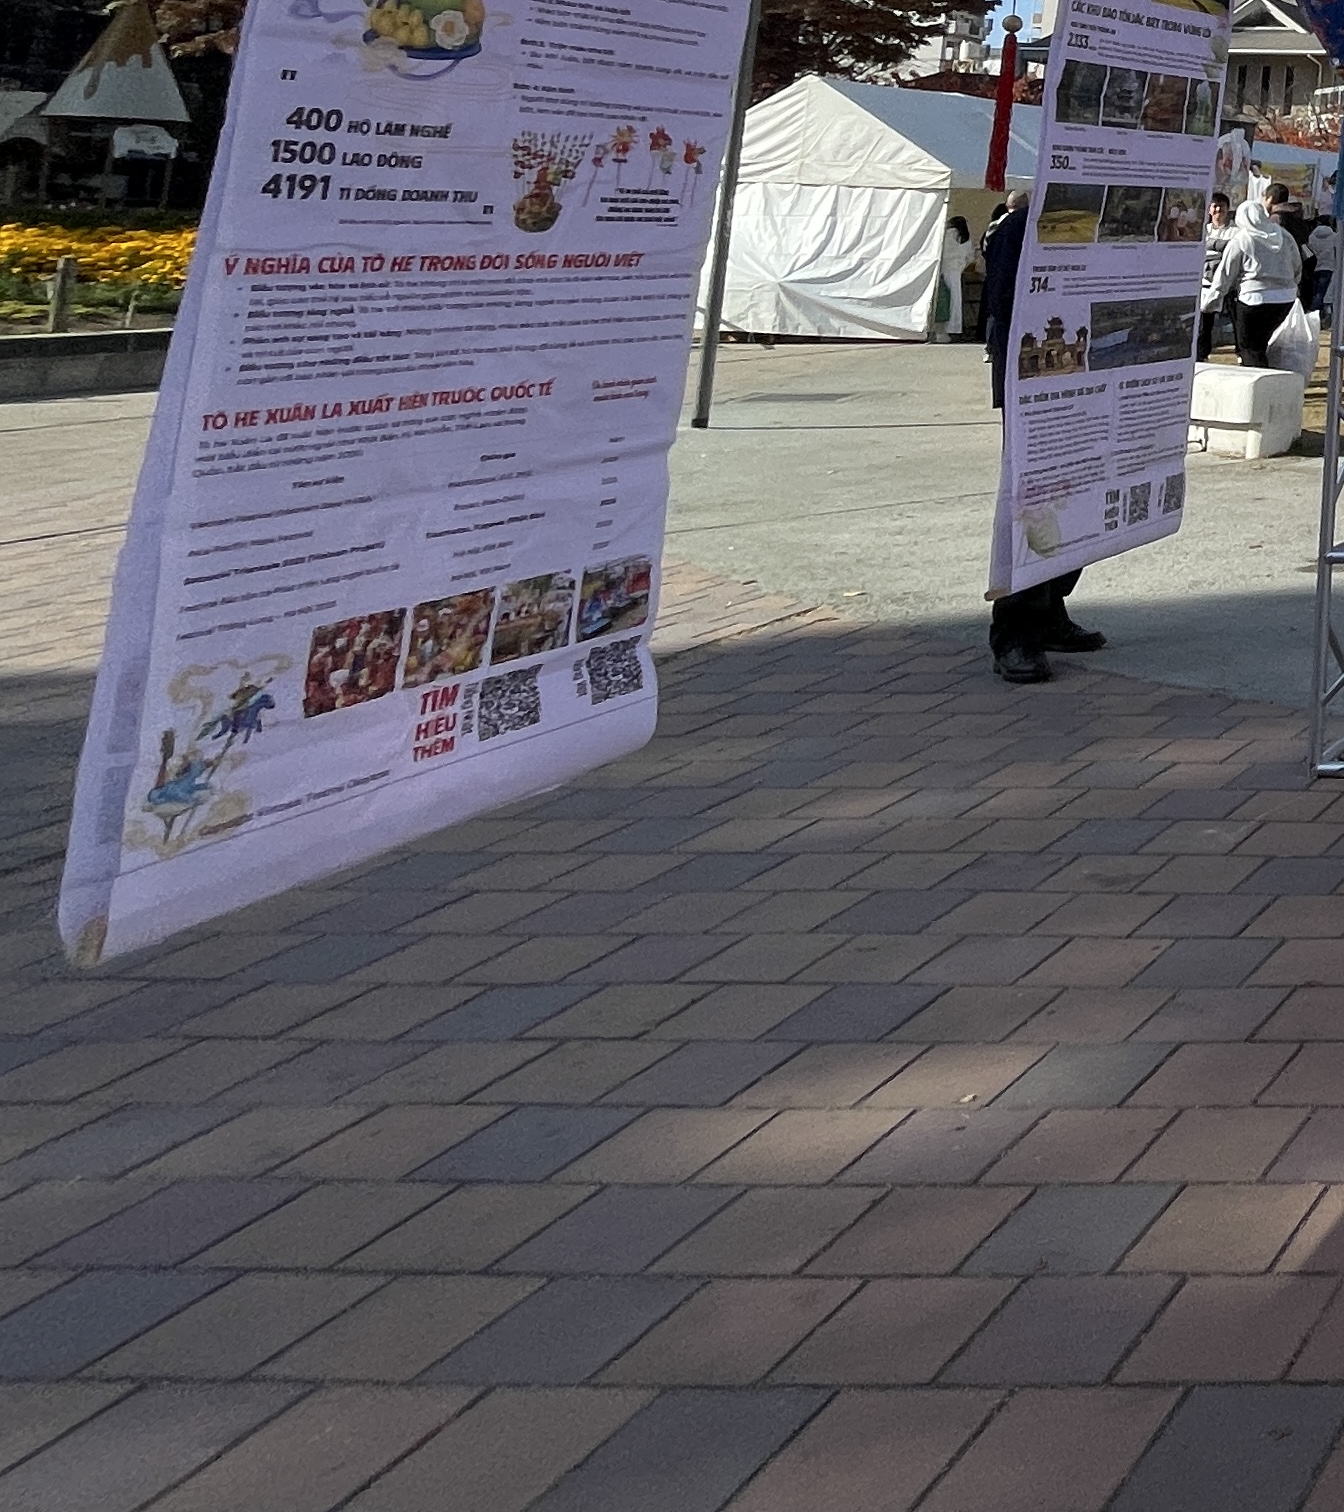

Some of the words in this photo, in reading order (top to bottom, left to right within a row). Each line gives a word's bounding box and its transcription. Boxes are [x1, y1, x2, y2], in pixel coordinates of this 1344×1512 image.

[285, 106, 344, 133] 400
[270, 139, 337, 165] 1500
[341, 152, 373, 168] LAO
[260, 173, 332, 201] 4191
[317, 251, 356, 274] CỦA
[389, 255, 416, 273] HE
[420, 253, 477, 272] TRONG
[233, 410, 259, 429] HE
[264, 402, 317, 425] XUÂN
[321, 402, 343, 419] LA
[412, 735, 456, 763] THÊM
